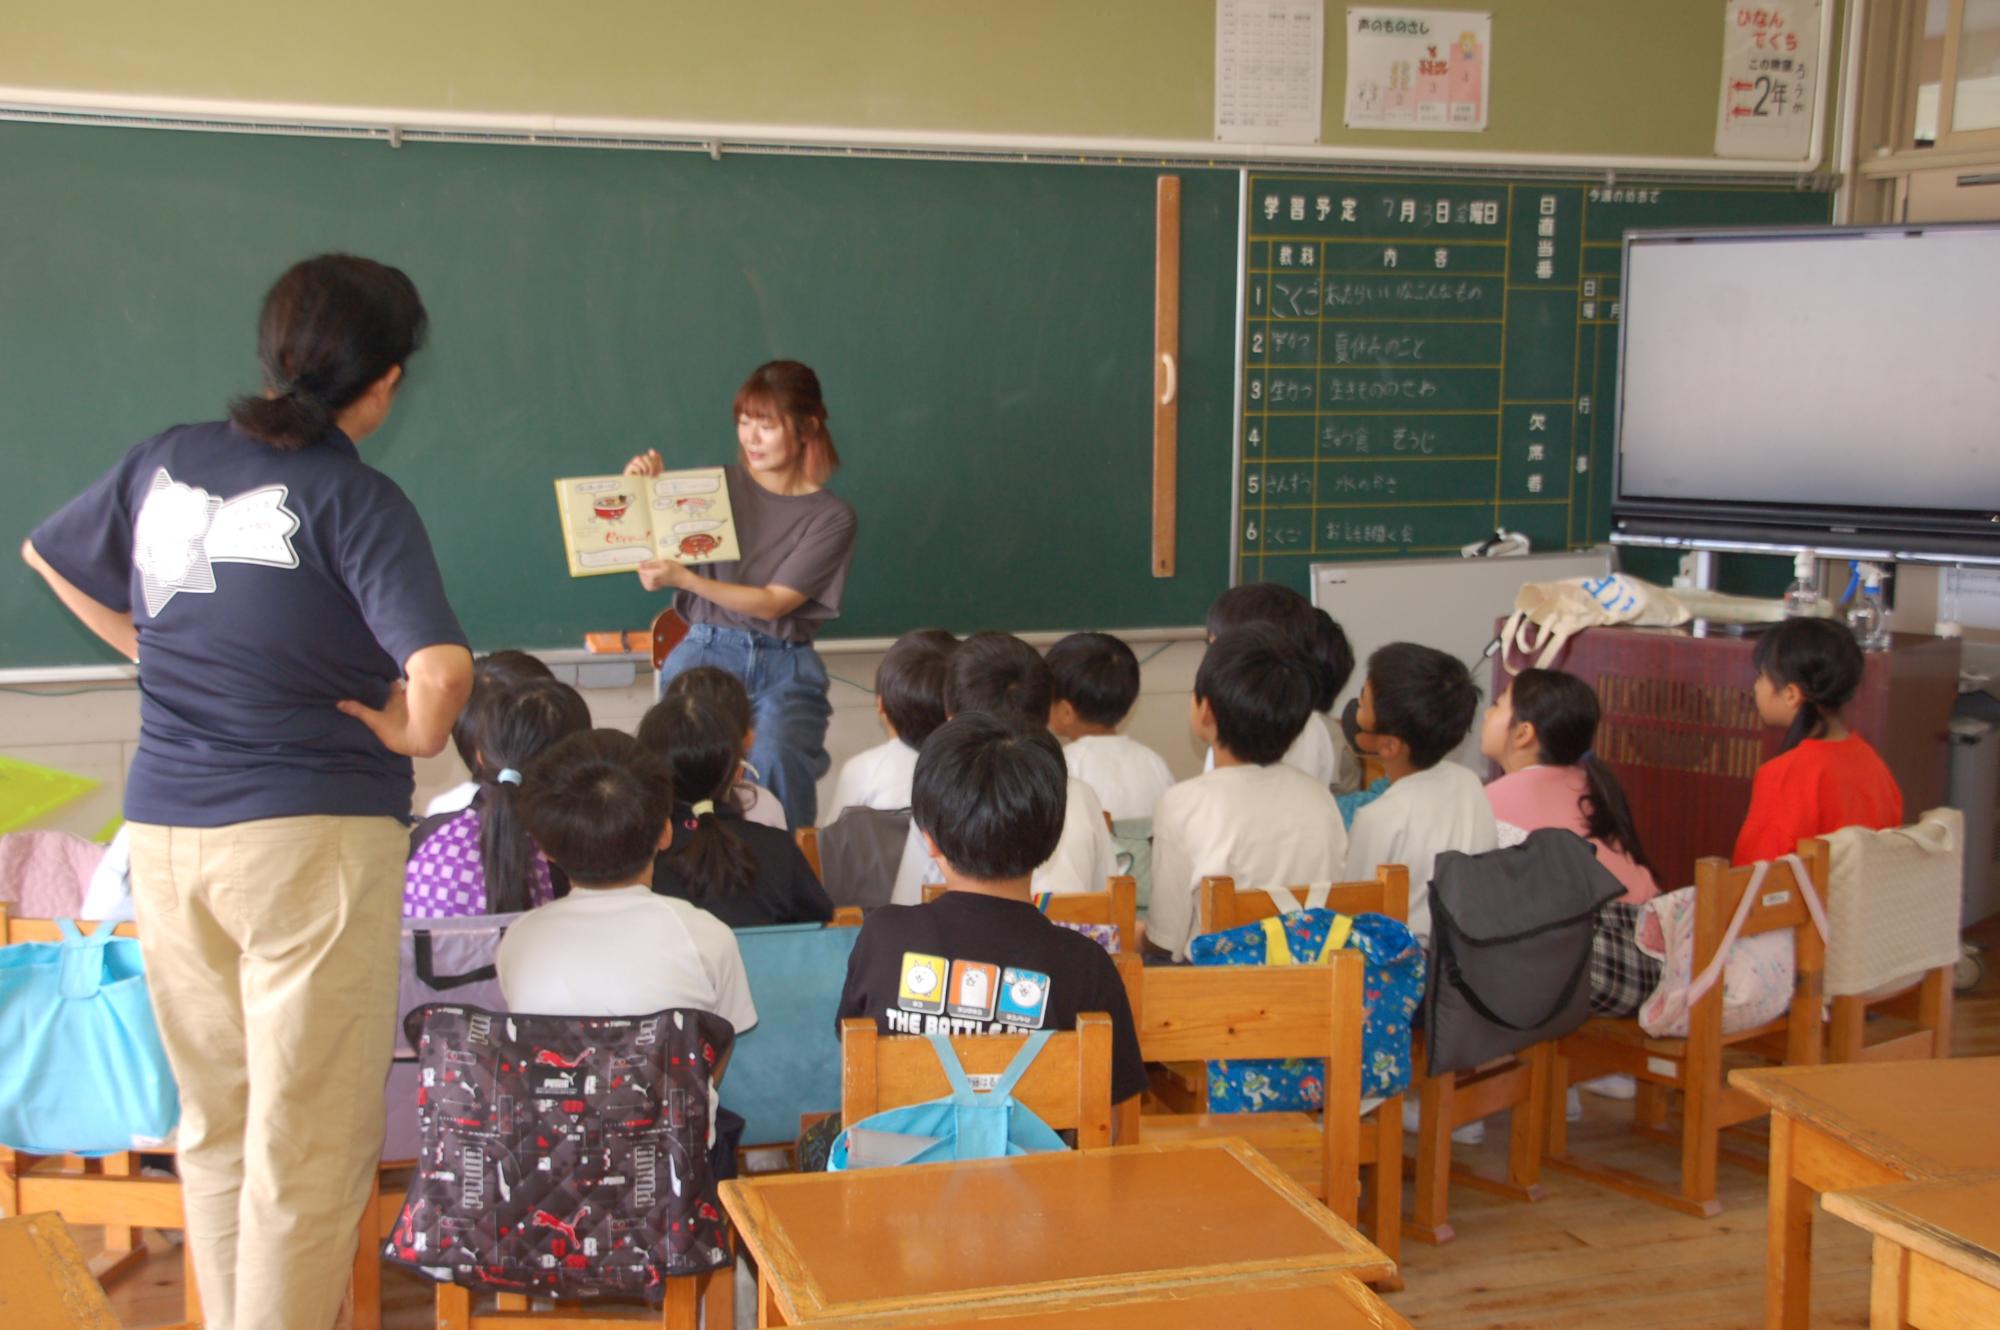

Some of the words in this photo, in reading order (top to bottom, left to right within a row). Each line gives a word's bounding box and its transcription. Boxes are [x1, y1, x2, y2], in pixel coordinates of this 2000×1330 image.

[1753, 76, 1788, 116] 2年
[1264, 195, 1357, 222] 学習予定
[1280, 245, 1315, 267] 教科
[1383, 248, 1448, 269] 内容
[1252, 334, 1263, 353] 2
[1250, 380, 1262, 400] 3
[1248, 428, 1260, 447] 4
[1528, 413, 1547, 493] 欠席者
[1247, 475, 1260, 495] 5
[1246, 521, 1258, 541] 6
[886, 1007, 921, 1035] THE
